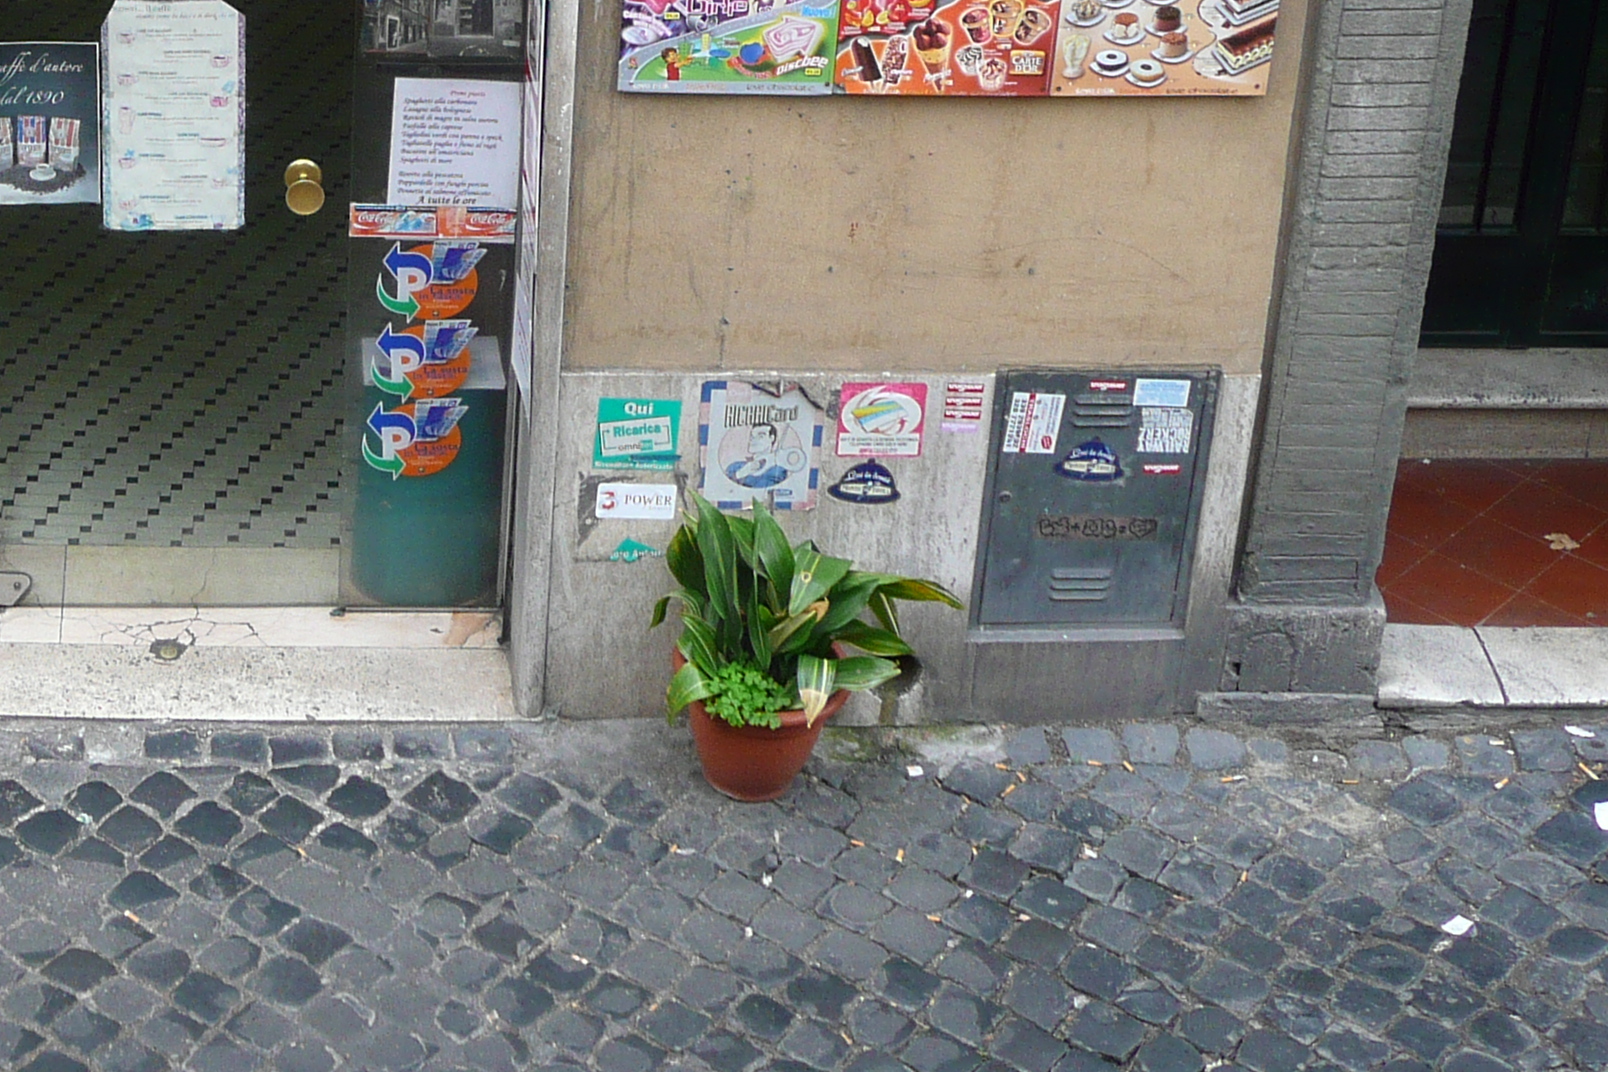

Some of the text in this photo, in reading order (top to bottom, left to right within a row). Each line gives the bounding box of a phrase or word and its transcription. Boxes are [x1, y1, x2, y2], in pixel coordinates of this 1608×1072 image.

[29, 53, 85, 73] d'autore
[1012, 55, 1043, 66] CARTE
[25, 90, 65, 104] 1890
[427, 196, 450, 204] tutte
[397, 267, 427, 302] P
[430, 286, 444, 295] La
[390, 349, 420, 383] P
[624, 402, 654, 416] Qui
[613, 424, 661, 437] Ricarica
[381, 427, 412, 460] P
[600, 491, 673, 510] 3 POWER
